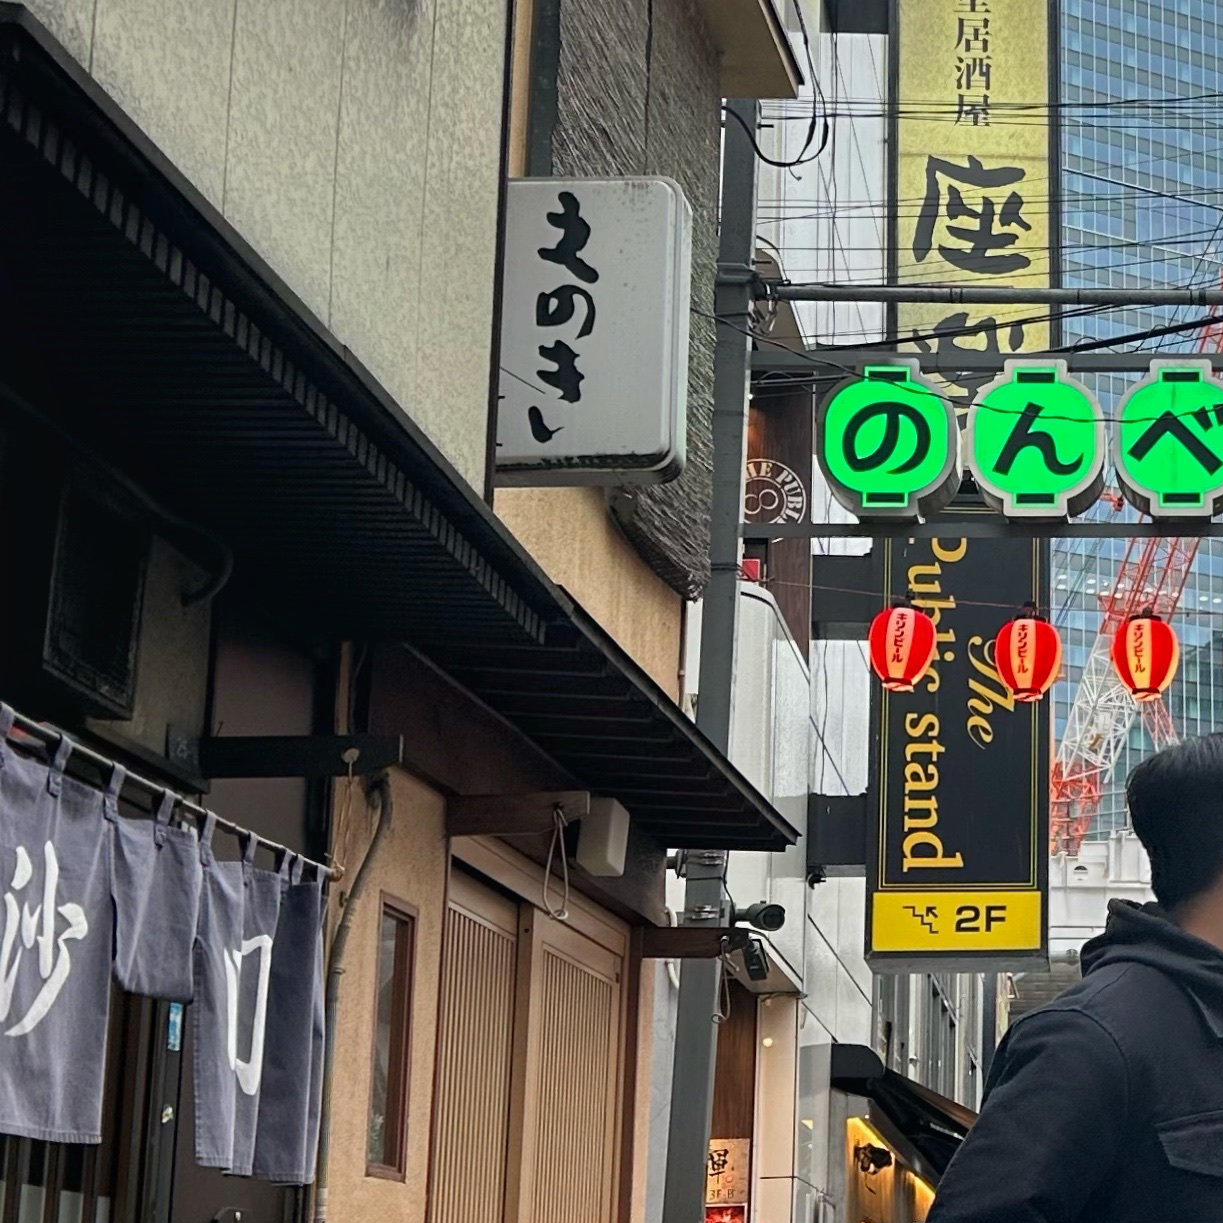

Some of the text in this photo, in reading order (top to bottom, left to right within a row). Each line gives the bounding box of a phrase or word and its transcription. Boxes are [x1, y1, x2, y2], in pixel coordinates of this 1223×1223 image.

[891, 613, 908, 663] キリンビール
[1017, 624, 1029, 674] キリンビール
[1133, 624, 1146, 673] キリンビール
[902, 713, 964, 873] stand
[954, 905, 1007, 933] 2F
